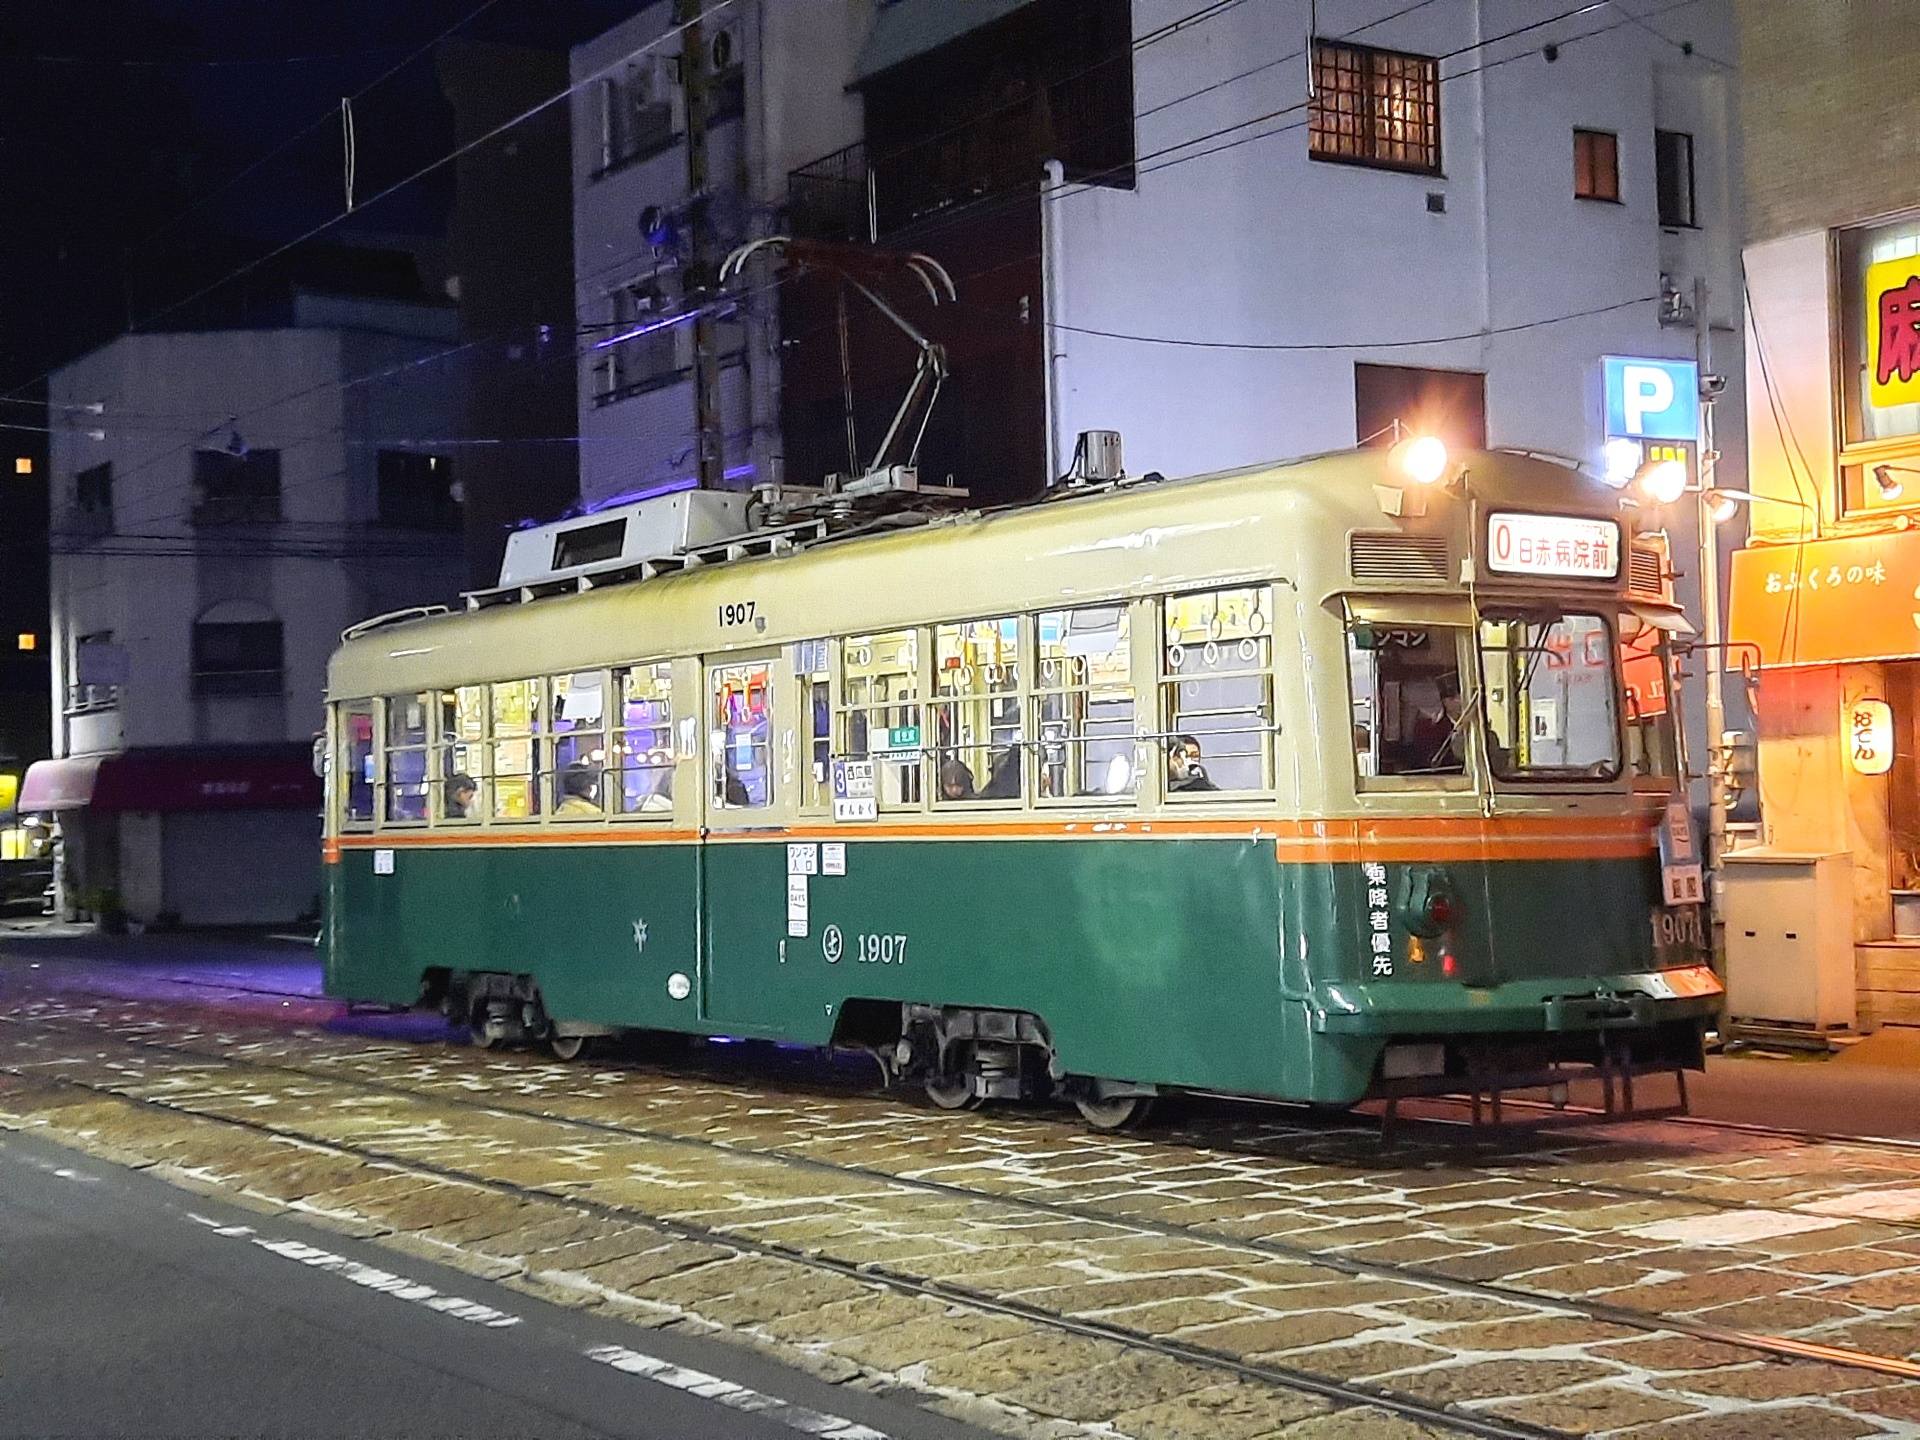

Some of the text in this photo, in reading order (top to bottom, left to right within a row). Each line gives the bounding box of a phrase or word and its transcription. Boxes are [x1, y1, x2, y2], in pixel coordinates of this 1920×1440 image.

[1623, 365, 1674, 434] P
[1496, 524, 1511, 560] 0
[1519, 537, 1609, 570] 日赤病院前
[1764, 559, 1887, 594] おふくろの味
[718, 601, 756, 627] 1907
[1853, 711, 1875, 761] おでん
[835, 769, 846, 793] 3
[789, 846, 815, 859] ワンマン
[858, 934, 907, 964] 1907
